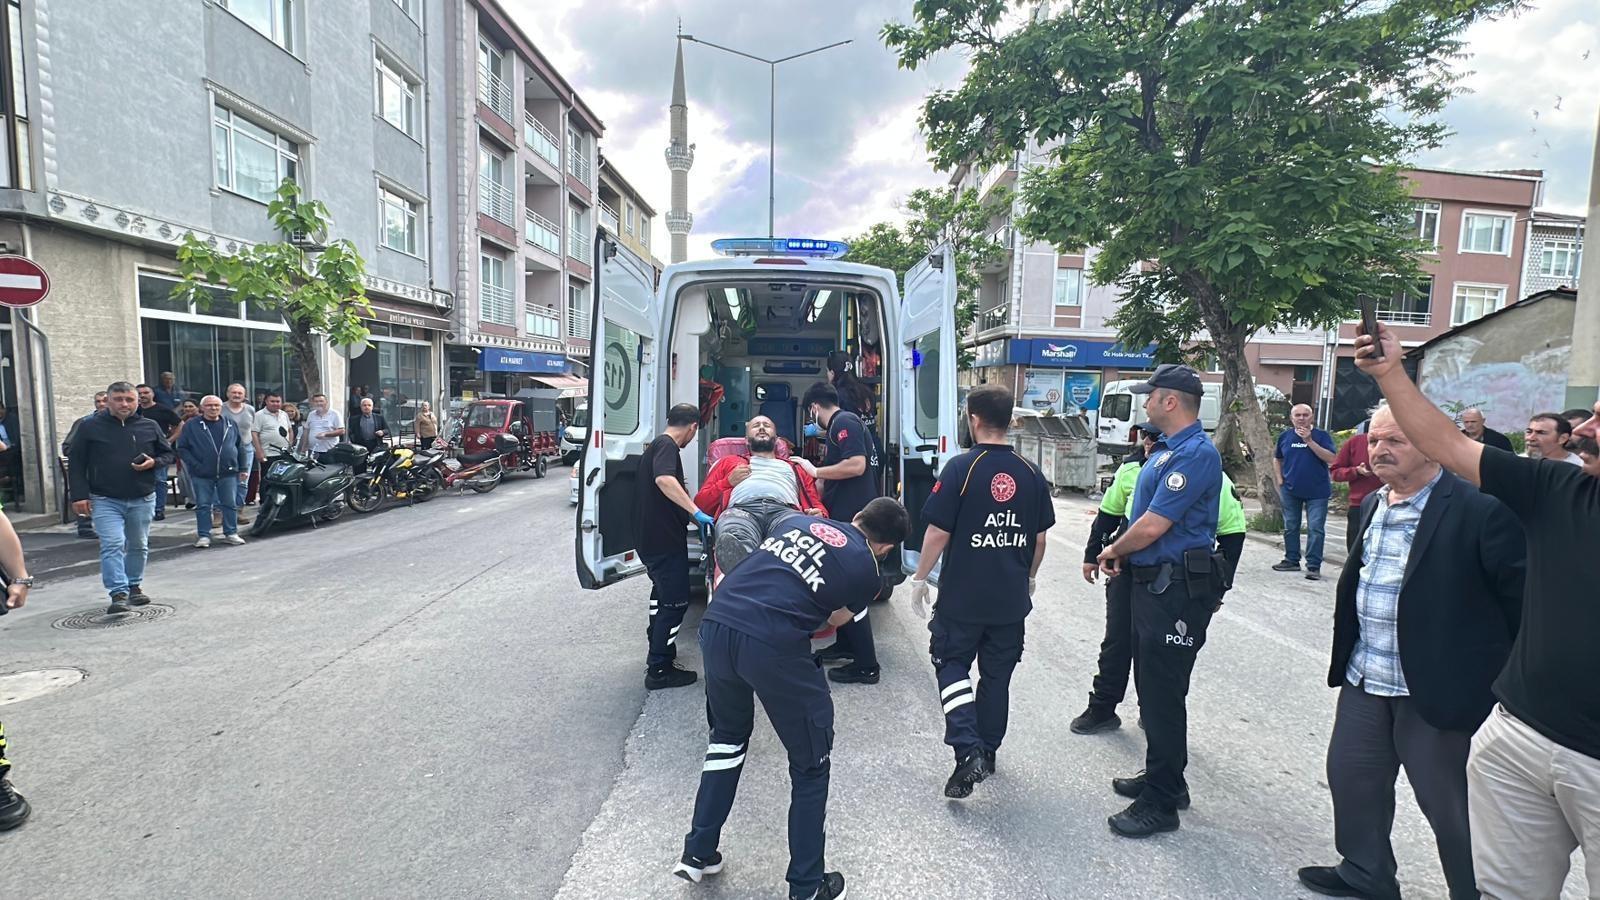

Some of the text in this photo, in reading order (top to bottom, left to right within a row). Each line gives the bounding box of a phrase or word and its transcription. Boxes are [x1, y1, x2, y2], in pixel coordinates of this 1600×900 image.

[1042, 349, 1076, 358] Marshall
[984, 510, 1021, 527] ACİL
[971, 530, 1027, 548] SAĞLIK
[760, 537, 825, 592] SAĞLIK
